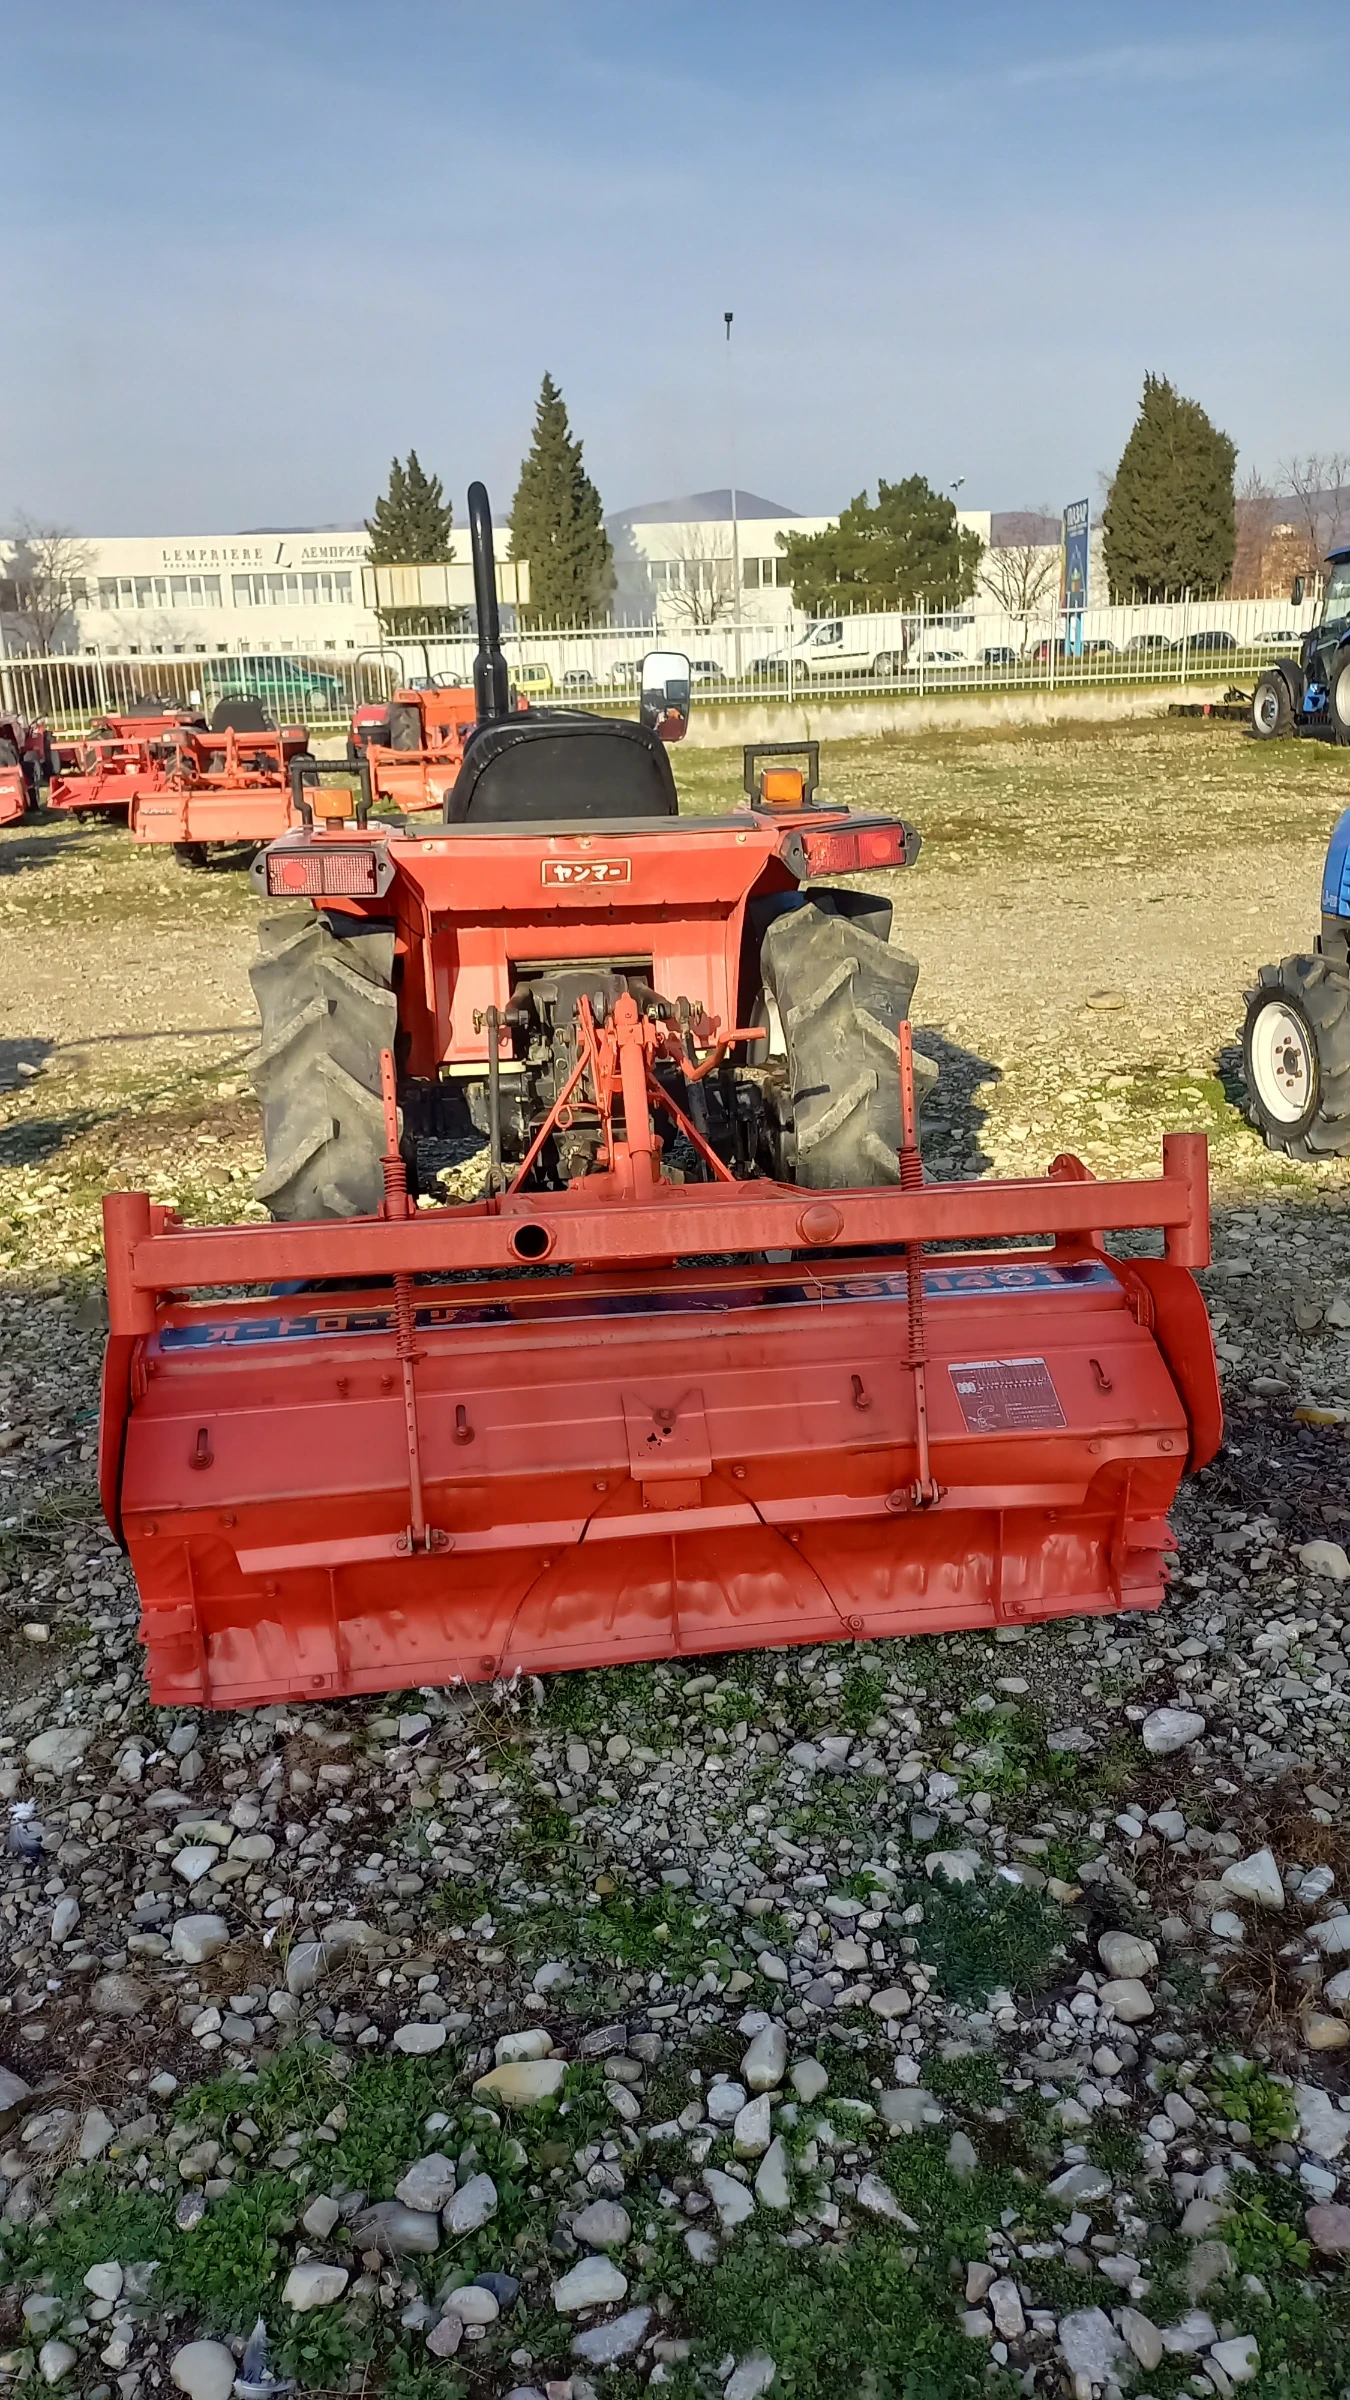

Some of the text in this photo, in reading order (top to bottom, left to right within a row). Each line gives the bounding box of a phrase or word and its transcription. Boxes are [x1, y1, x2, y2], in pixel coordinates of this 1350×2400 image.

[162, 549, 263, 561] LEMPRIERE
[553, 864, 621, 882] ヤンマー
